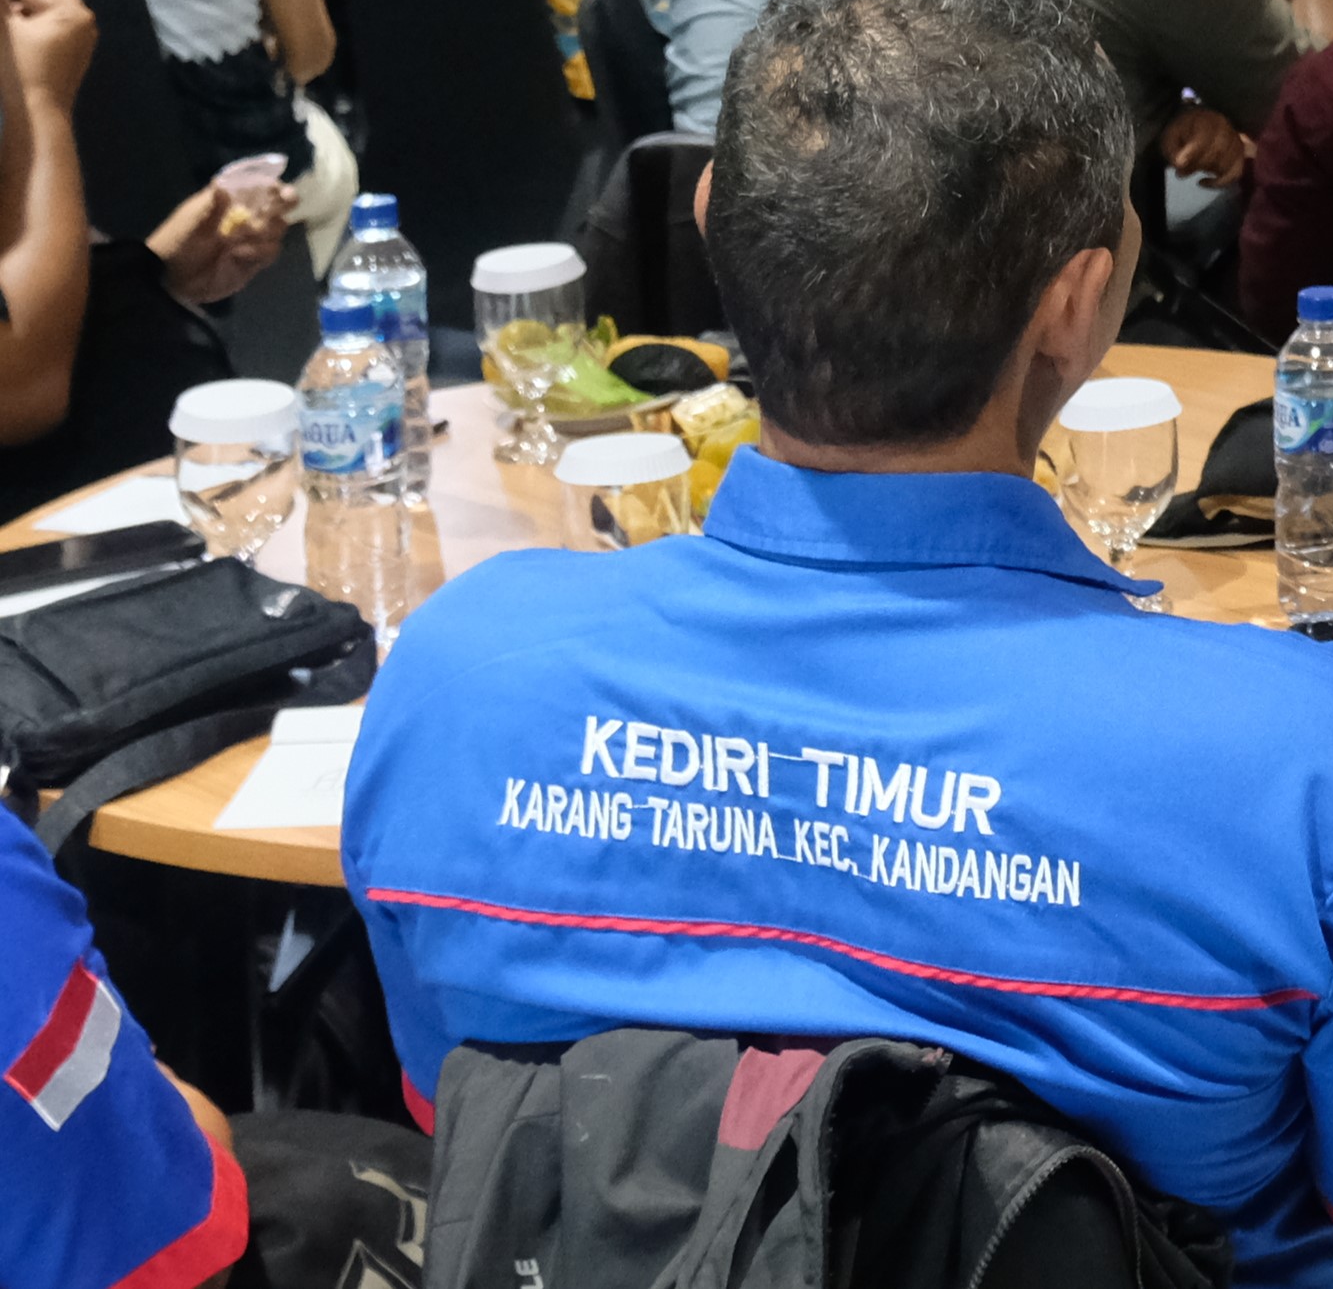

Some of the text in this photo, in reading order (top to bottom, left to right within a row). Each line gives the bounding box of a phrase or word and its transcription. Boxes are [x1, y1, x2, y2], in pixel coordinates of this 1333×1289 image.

[579, 715, 1003, 835] KEDIRI TIMUR
[498, 776, 633, 841] KARANG
[646, 796, 778, 858] TARUNA
[869, 832, 1081, 907] KANDANGAN
